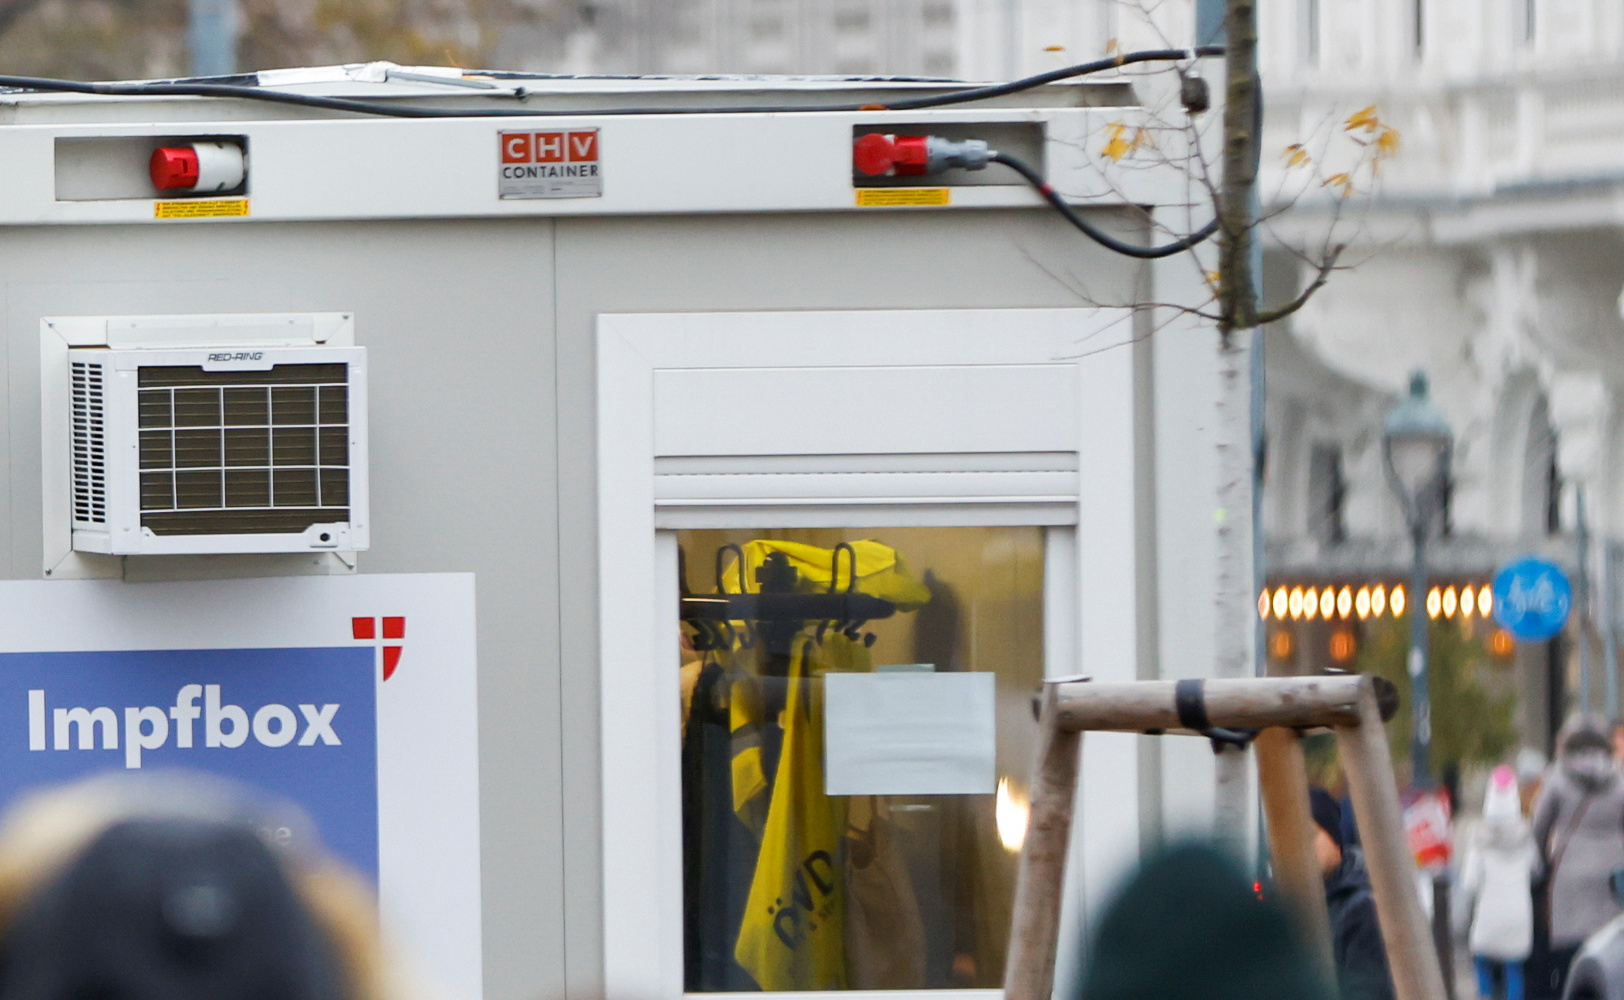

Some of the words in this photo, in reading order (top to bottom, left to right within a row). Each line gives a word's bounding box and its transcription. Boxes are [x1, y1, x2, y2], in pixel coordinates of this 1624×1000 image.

[508, 136, 594, 159] CHV
[503, 164, 599, 179] CONTAINER
[208, 352, 264, 362] RED-RING
[27, 684, 342, 769] Impfbox
